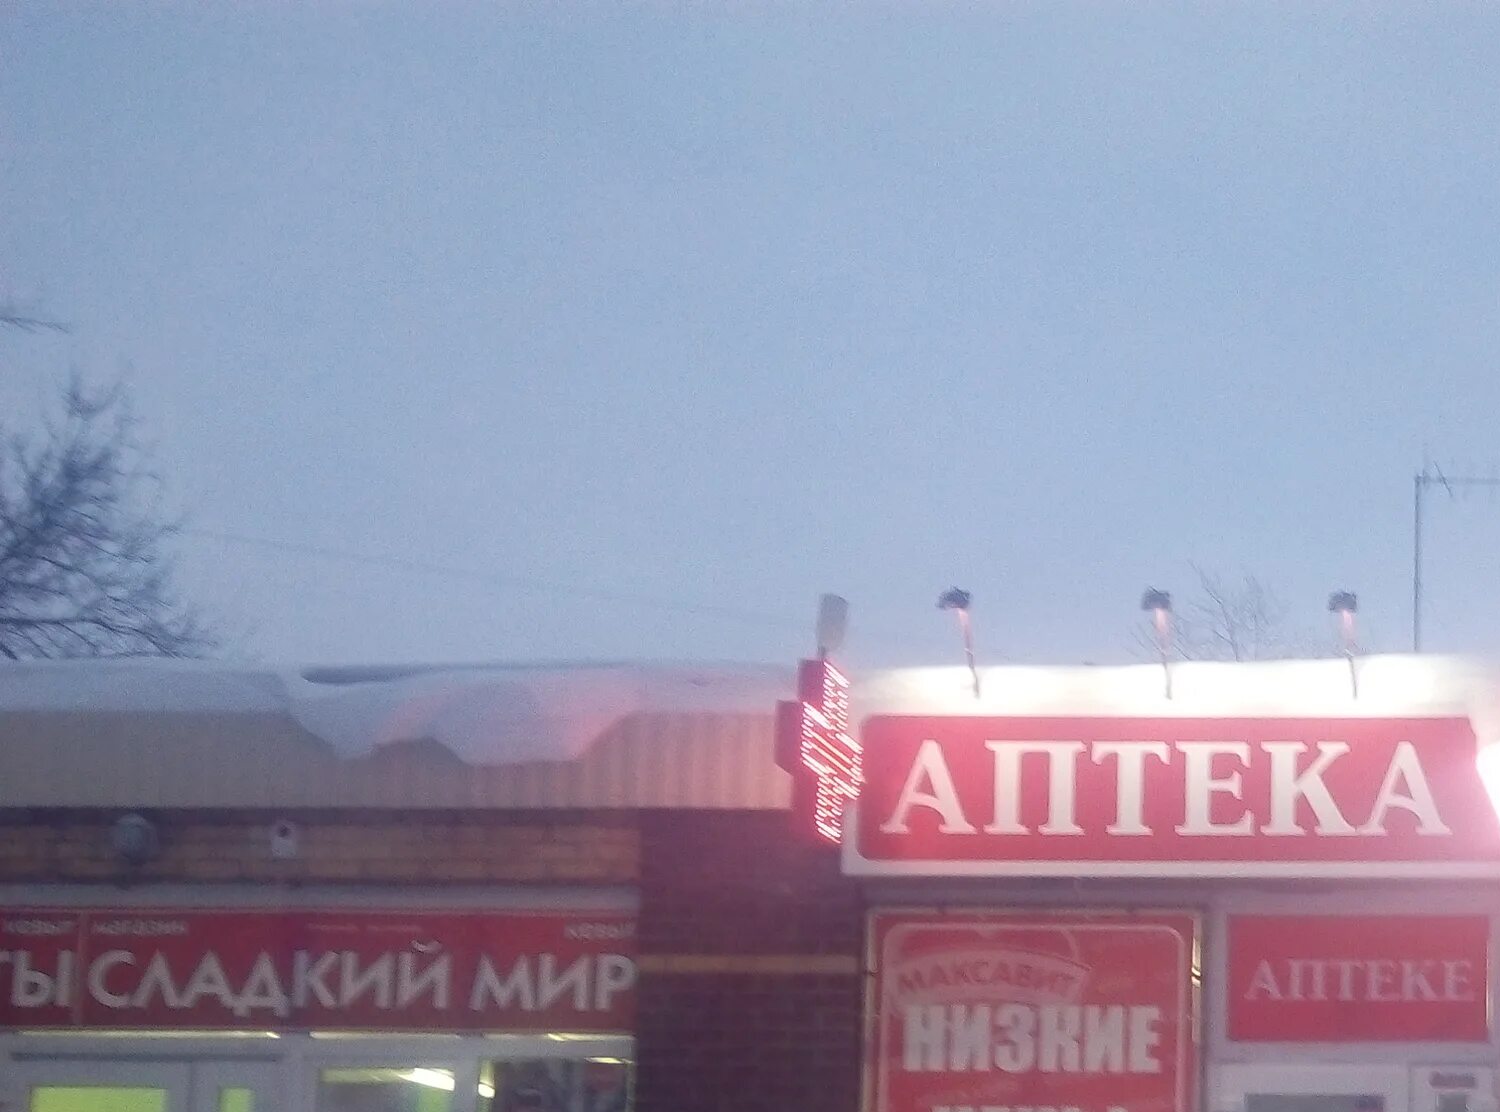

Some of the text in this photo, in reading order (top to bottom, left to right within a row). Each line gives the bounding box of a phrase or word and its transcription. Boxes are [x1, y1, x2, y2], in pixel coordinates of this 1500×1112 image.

[880, 739, 1453, 836] АПТЕКА
[87, 939, 638, 1018] СЛАДКИЙ МИР
[902, 1003, 1163, 1074] НИЗКИЕ
